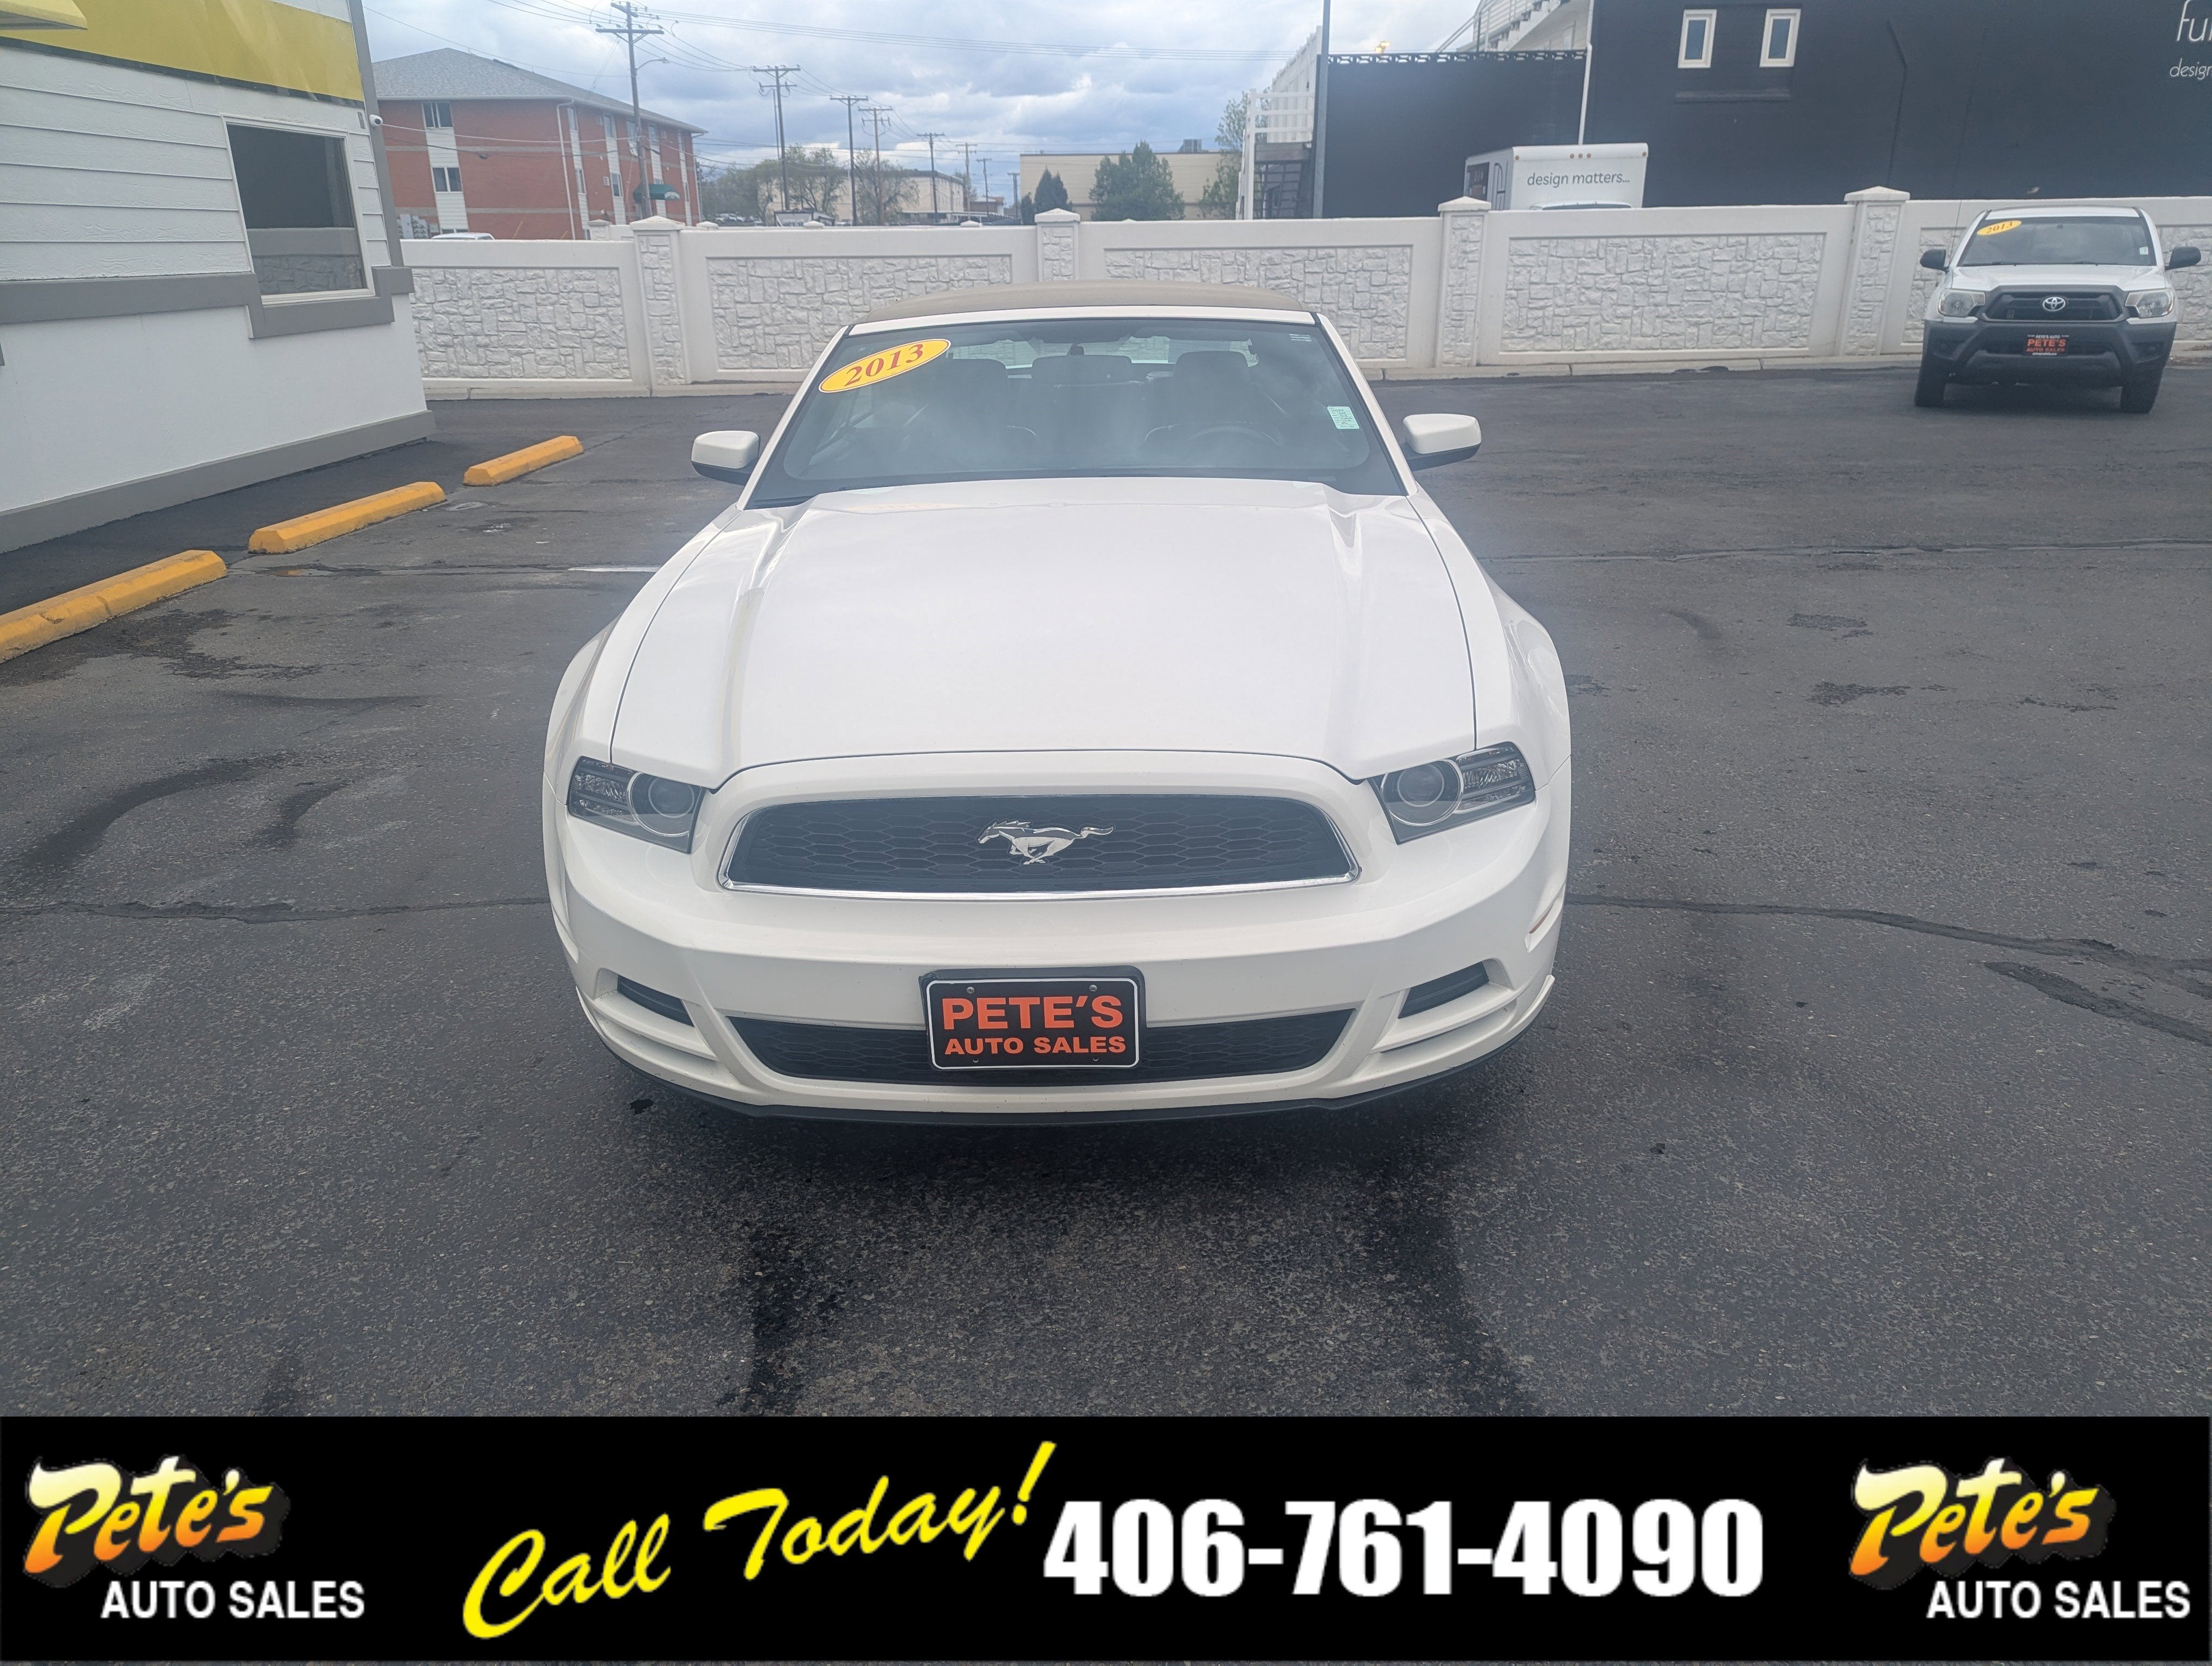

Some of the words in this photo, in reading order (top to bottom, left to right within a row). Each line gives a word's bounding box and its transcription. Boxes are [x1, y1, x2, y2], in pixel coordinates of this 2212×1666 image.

[2176, 0, 2212, 42] fu
[1527, 172, 1568, 188] design
[1572, 172, 1630, 184] matters...
[2028, 338, 2066, 347] PETE'S
[844, 344, 924, 387] 2013
[942, 995, 1123, 1030] PETE'S
[944, 1037, 1024, 1055] AUTO
[1033, 1036, 1126, 1054] SALES
